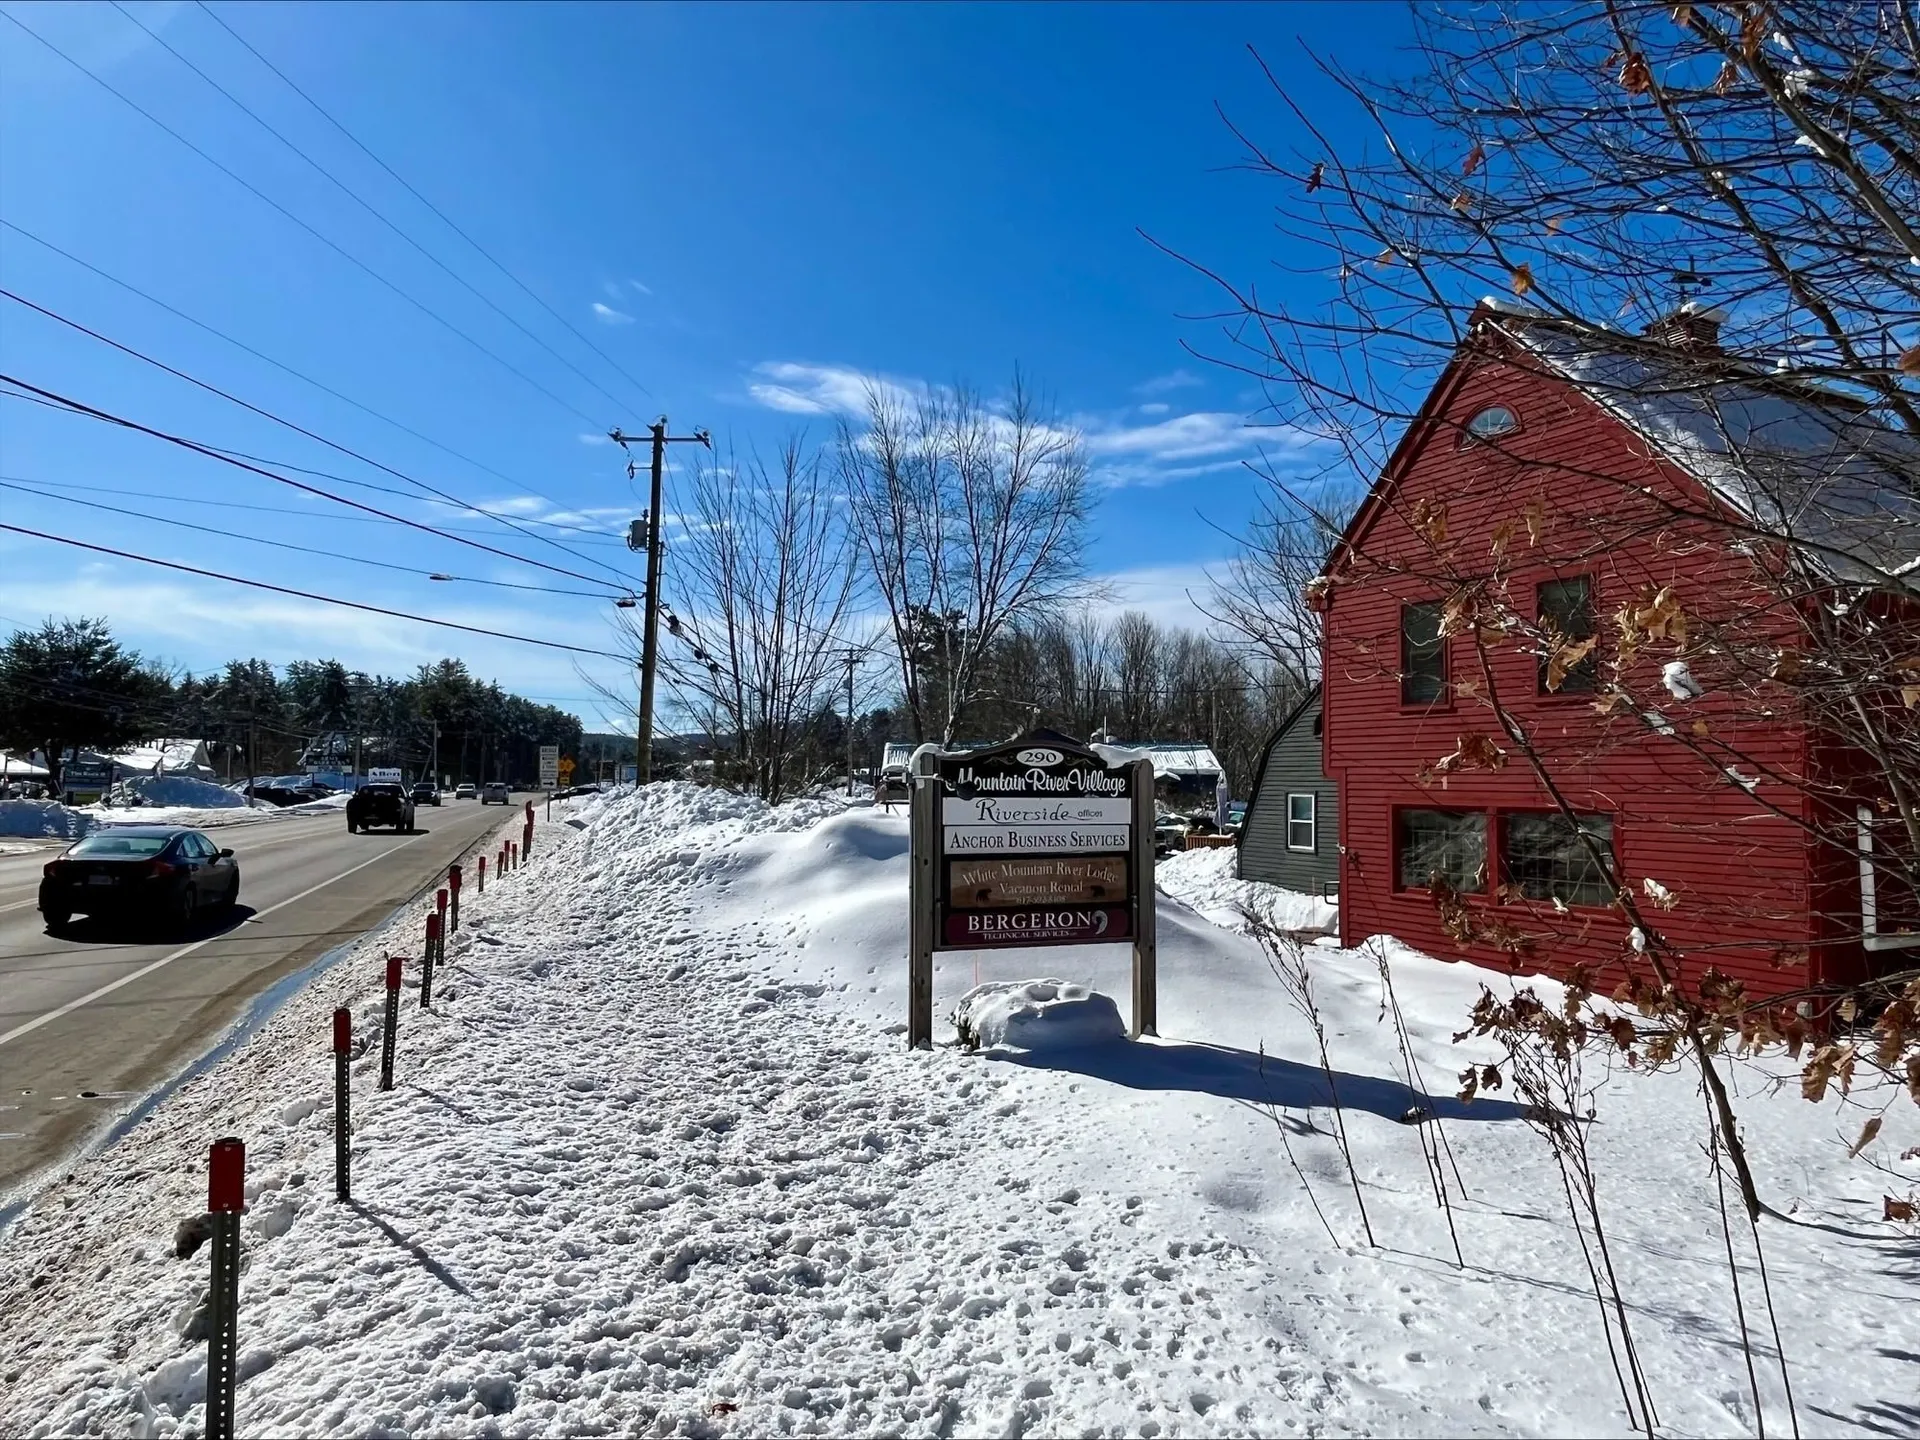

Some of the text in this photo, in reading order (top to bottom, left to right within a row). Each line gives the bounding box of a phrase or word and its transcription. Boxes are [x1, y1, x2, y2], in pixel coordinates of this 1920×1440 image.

[1024, 752, 1058, 763] 290
[945, 766, 1126, 797] Mountain River Village
[975, 798, 1103, 824] Riverside offices
[950, 831, 1126, 849] ANCHOR BUSINESS SERVICES
[962, 861, 1119, 886] White Mountain River Lodge
[999, 880, 1084, 894] Vacation Rental
[967, 911, 1091, 931] BERGERON
[982, 931, 1030, 940] TECHNICAL
[1033, 930, 1070, 938] SERVICES
